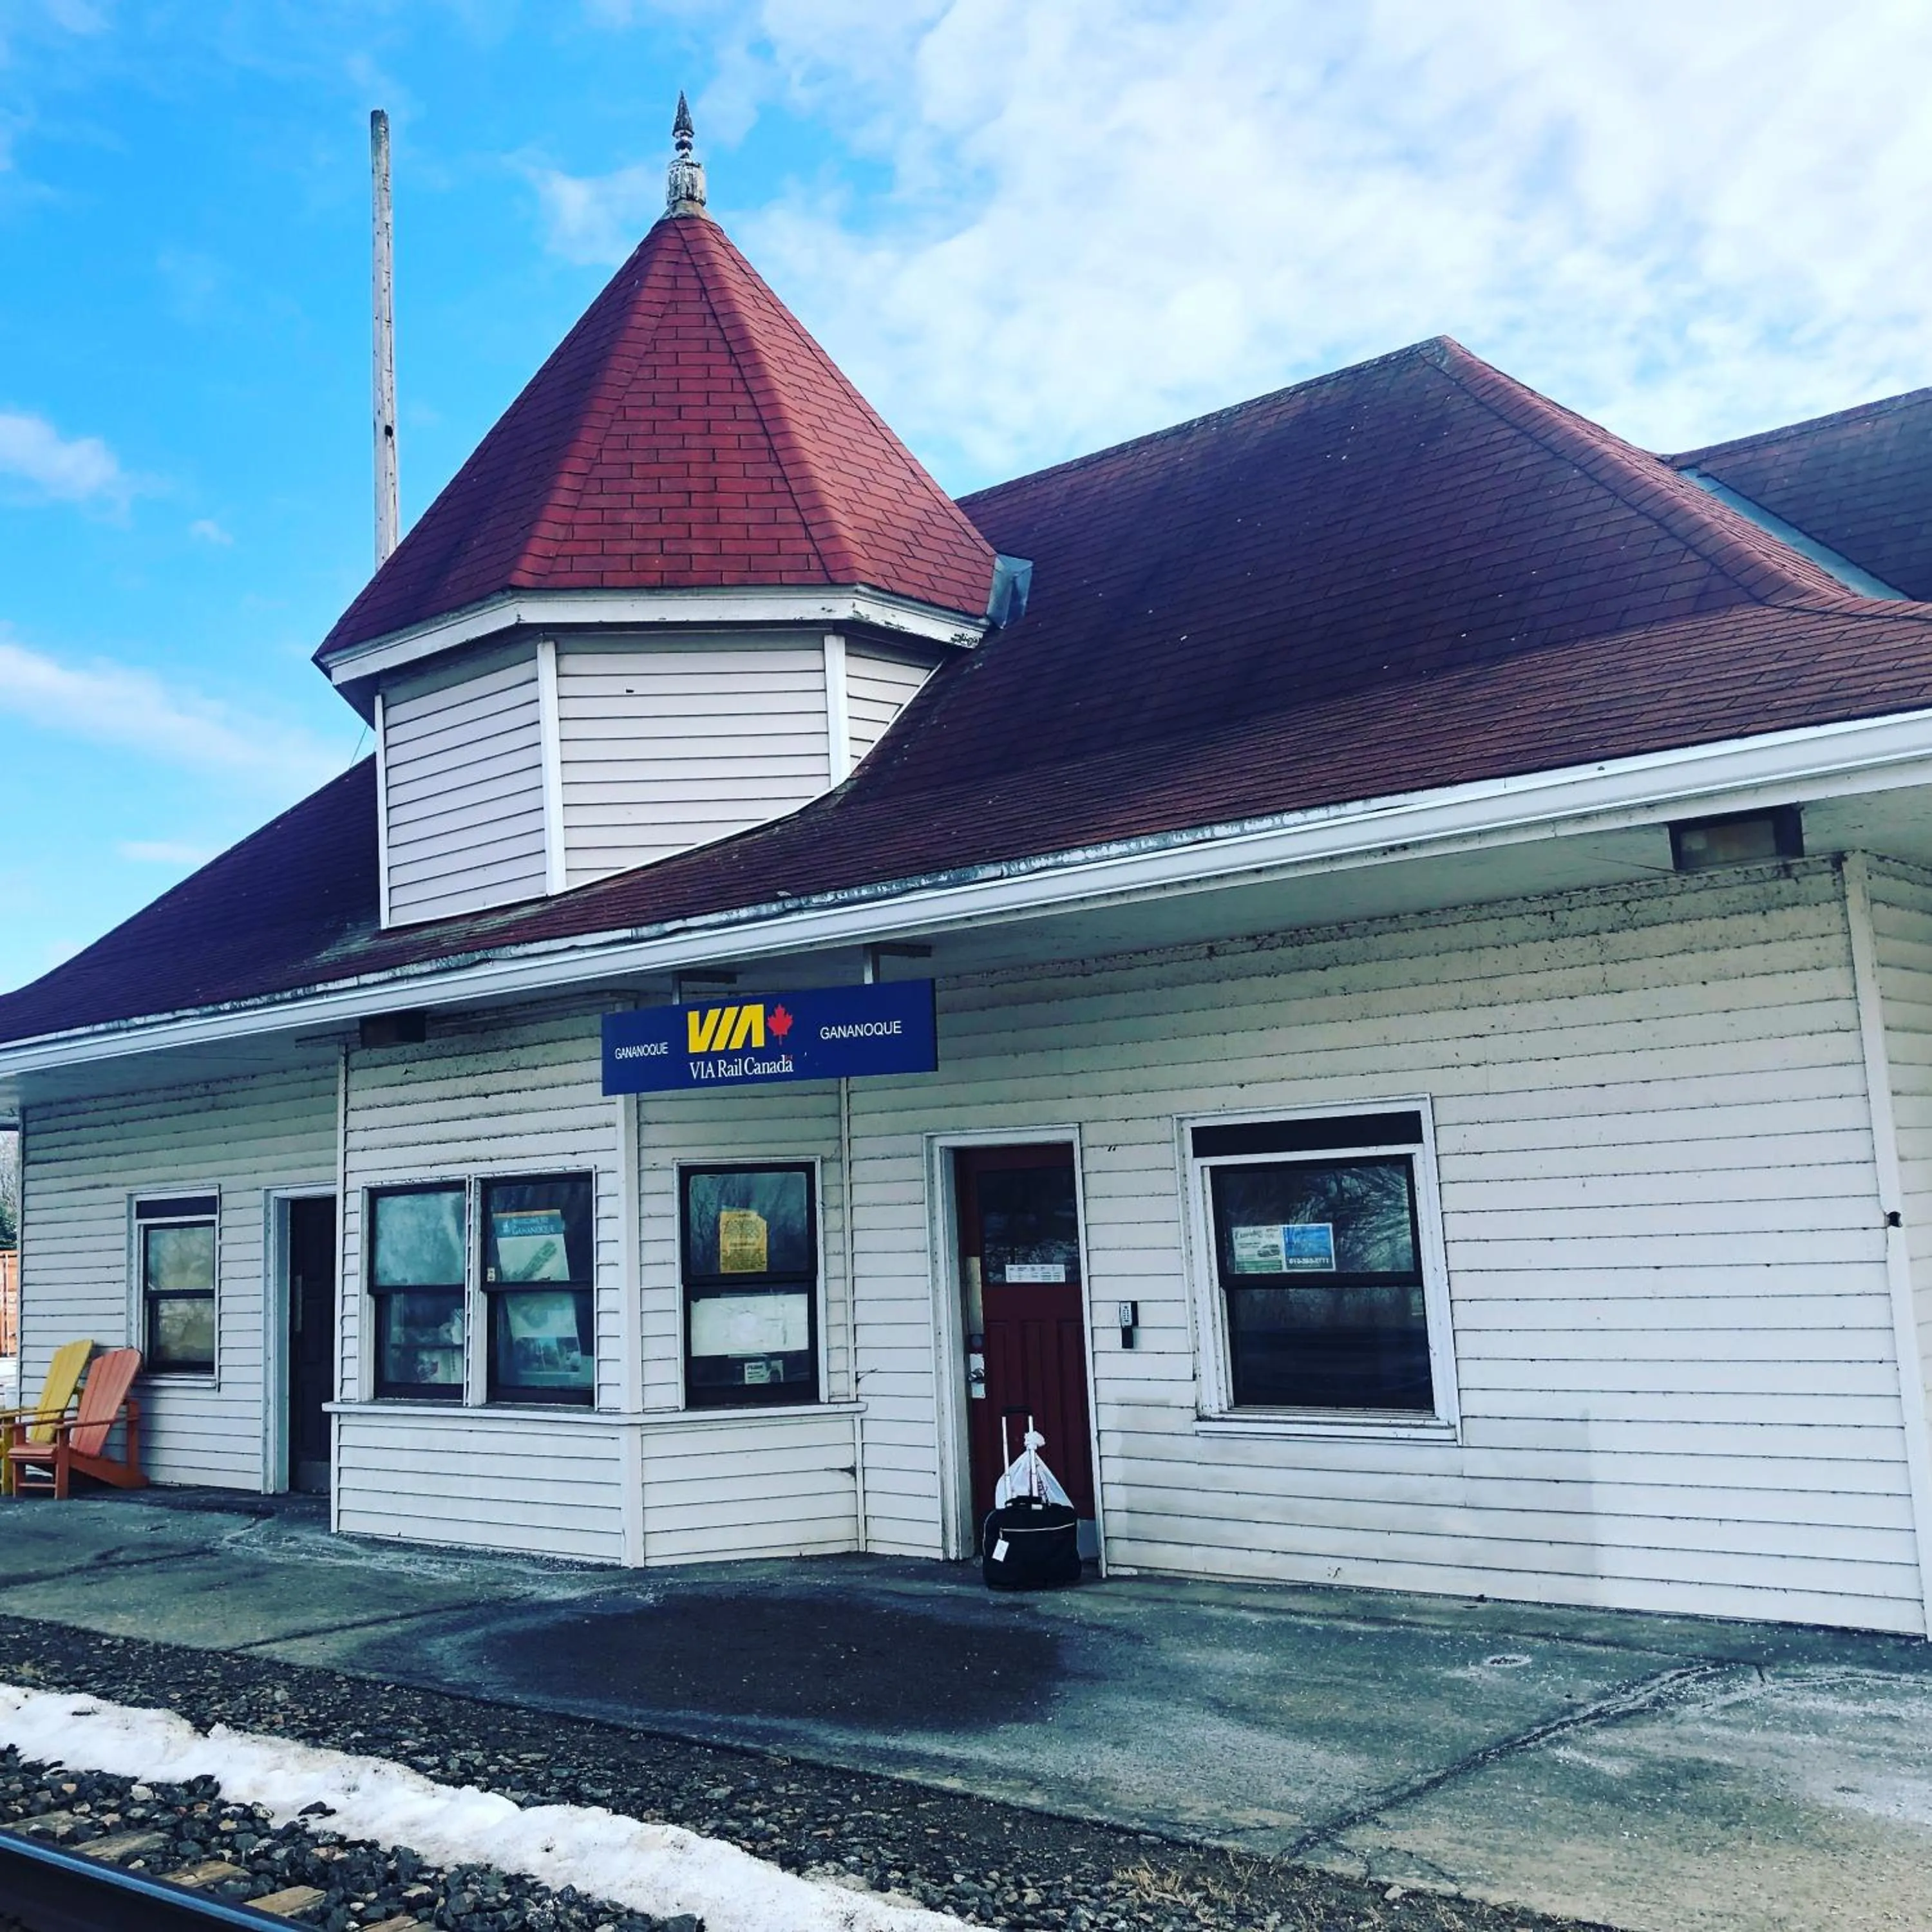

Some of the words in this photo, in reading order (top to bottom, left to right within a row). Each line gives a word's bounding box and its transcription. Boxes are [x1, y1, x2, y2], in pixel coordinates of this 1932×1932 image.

[687, 1004, 765, 1054] VIA
[820, 1020, 902, 1040] GANANOQUE
[614, 1041, 668, 1060] GANANOQUE
[689, 1061, 715, 1080] VIA
[717, 1058, 743, 1077] Rail
[744, 1054, 793, 1075] Canada
